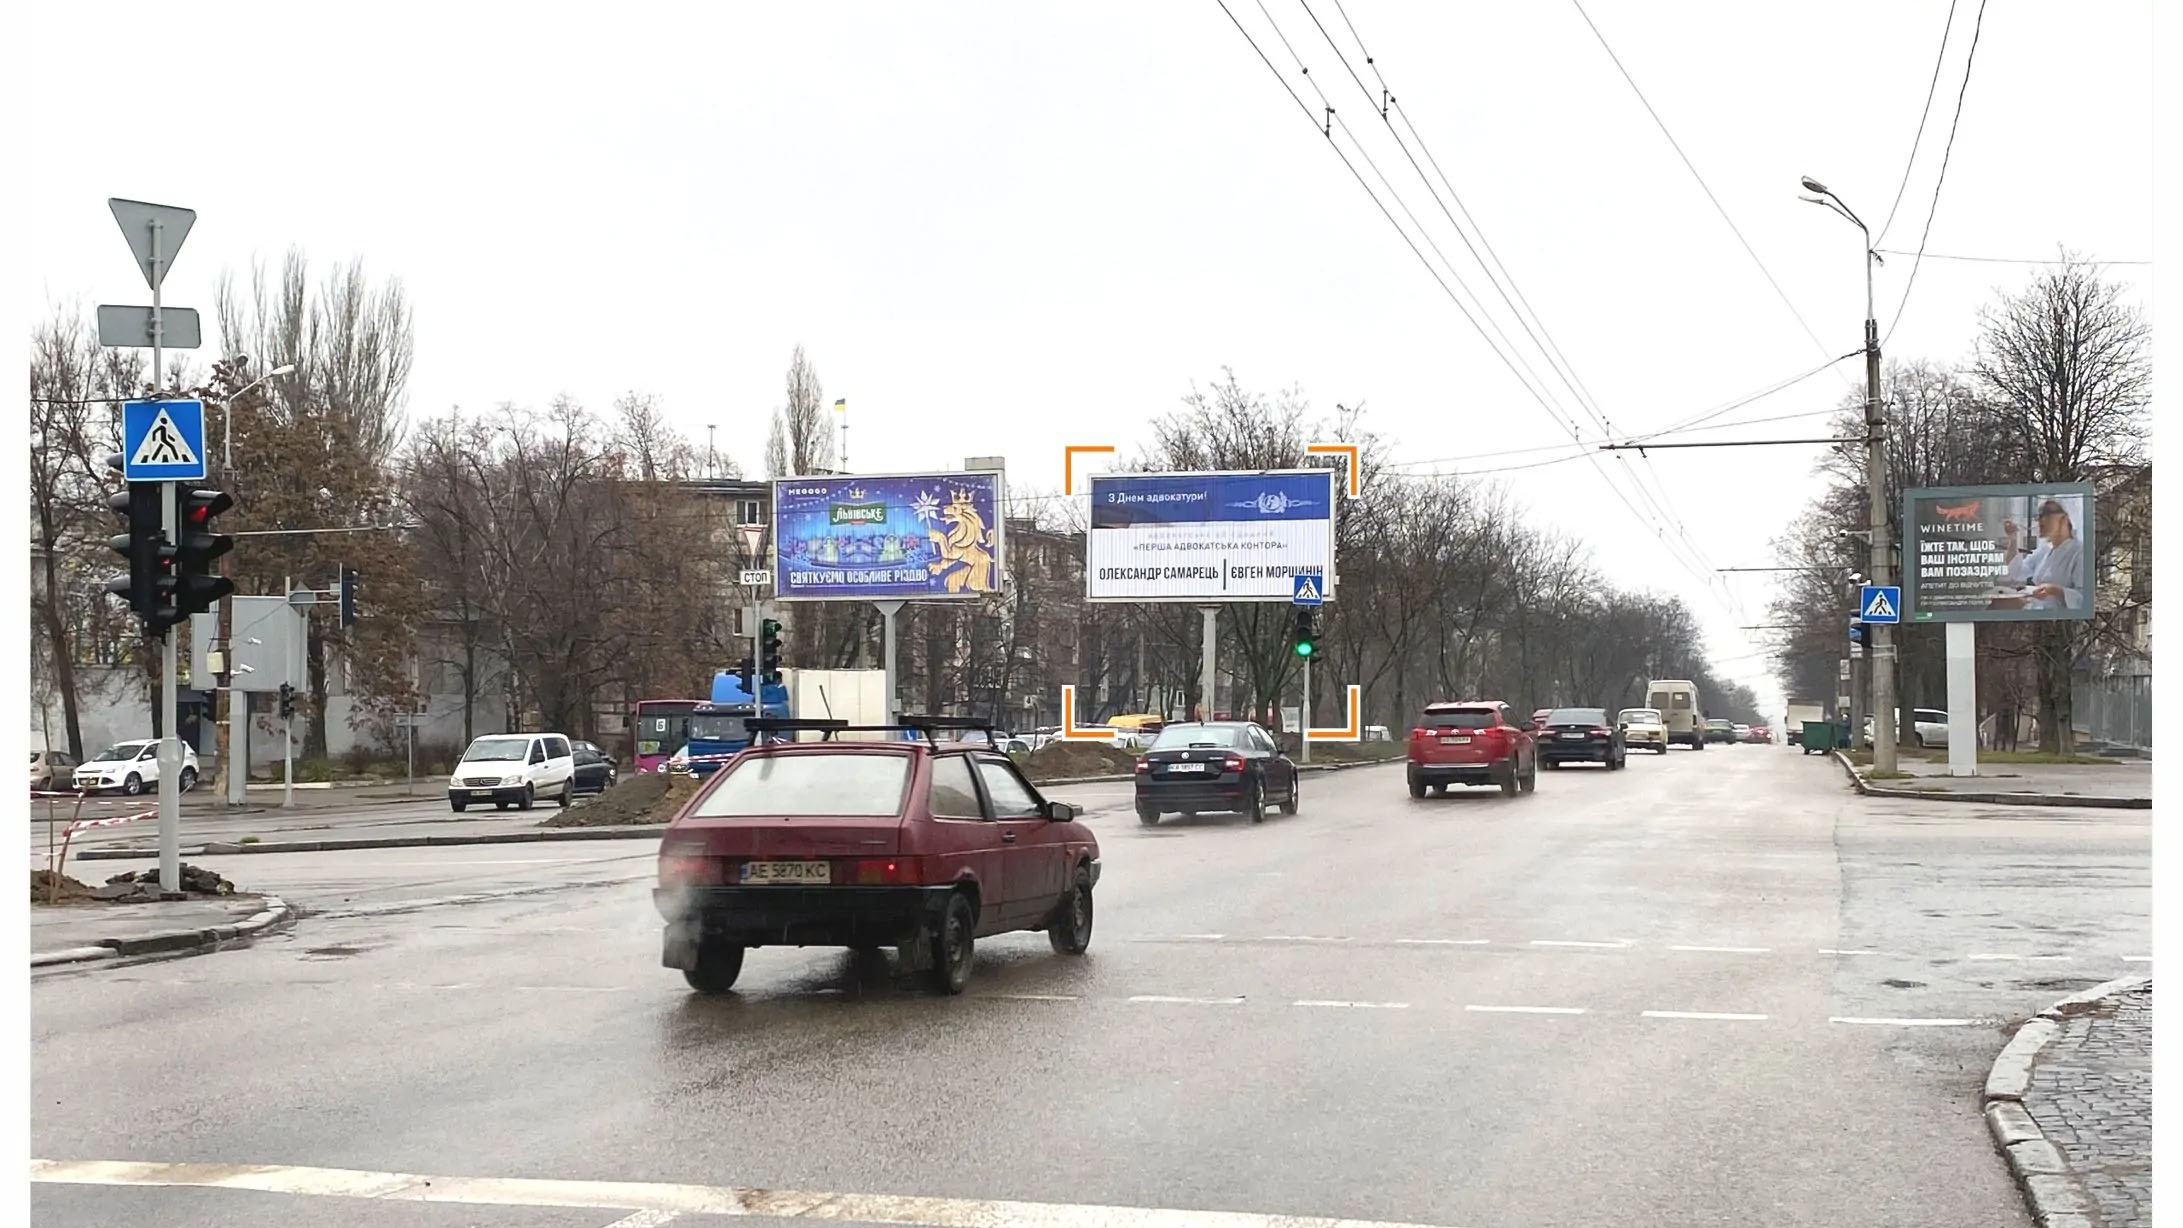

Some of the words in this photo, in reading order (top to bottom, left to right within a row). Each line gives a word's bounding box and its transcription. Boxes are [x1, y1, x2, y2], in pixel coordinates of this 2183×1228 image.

[788, 488, 827, 496] MEGOGO
[1108, 493, 1115, 502] З
[1117, 492, 1144, 503] Днем
[1146, 491, 1208, 503] адвокатури!
[1920, 523, 1984, 533] WINETIME
[1174, 542, 1239, 551] АДВОКАТСЬКА
[1920, 540, 1944, 552] ЇЖТЕ
[1946, 540, 1968, 552] ТАК,
[1970, 540, 1995, 552] ЩОБ
[1921, 554, 1944, 565] ВАШ
[1947, 553, 2004, 564] ІНСТАГРАМ
[744, 572, 768, 583] СТОП
[790, 570, 844, 584] СВЯТКУЄМО
[847, 570, 891, 583] ОСОБЛИВЕ
[894, 568, 928, 582] РІЗДВО
[1099, 567, 1162, 581] ОЛЕКСАНДР
[1163, 566, 1219, 580] САМАРЕЦЬ
[1231, 566, 1263, 579] ЄВГЕН
[1921, 566, 1944, 578] ВАМ
[1946, 565, 2009, 578] ПОЗАЗДРИВ
[751, 864, 768, 879] AE
[806, 863, 826, 878] KC
